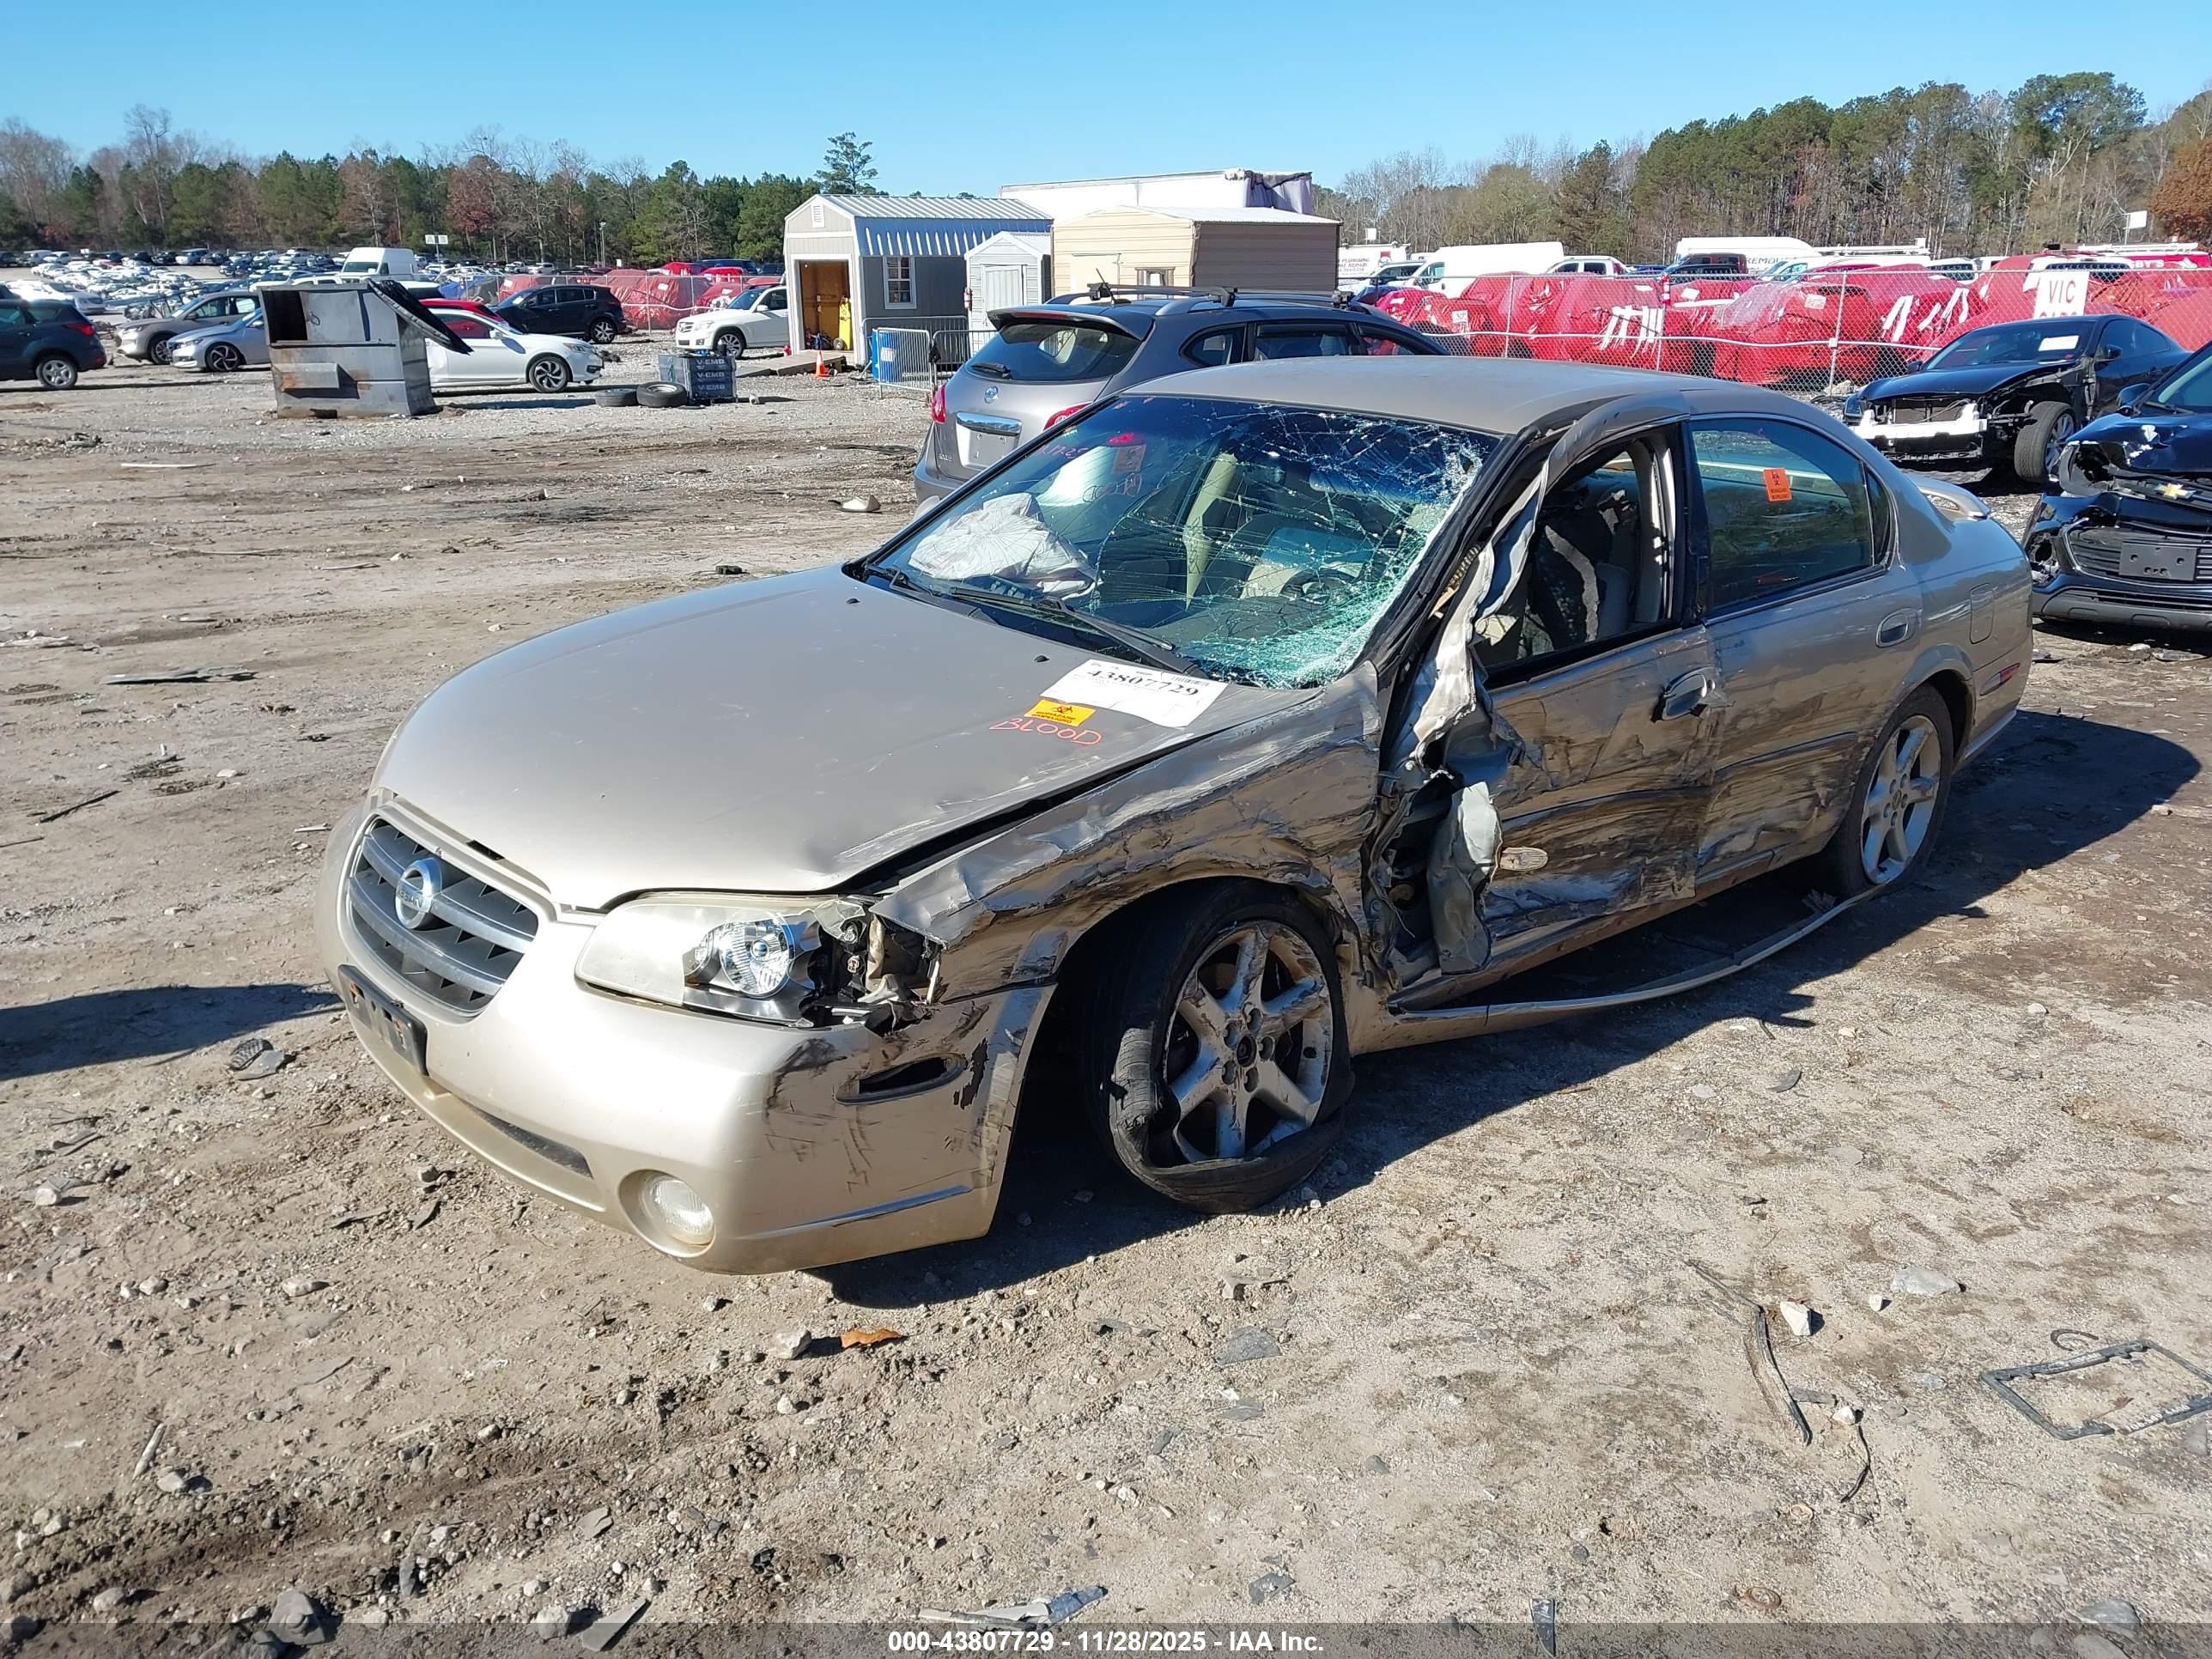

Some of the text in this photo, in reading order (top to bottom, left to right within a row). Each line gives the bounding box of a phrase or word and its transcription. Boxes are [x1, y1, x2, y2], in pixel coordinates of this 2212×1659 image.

[2048, 279, 2076, 304] VIC
[1086, 669, 1199, 697] 43807729
[989, 718, 1103, 745] BLOOD
